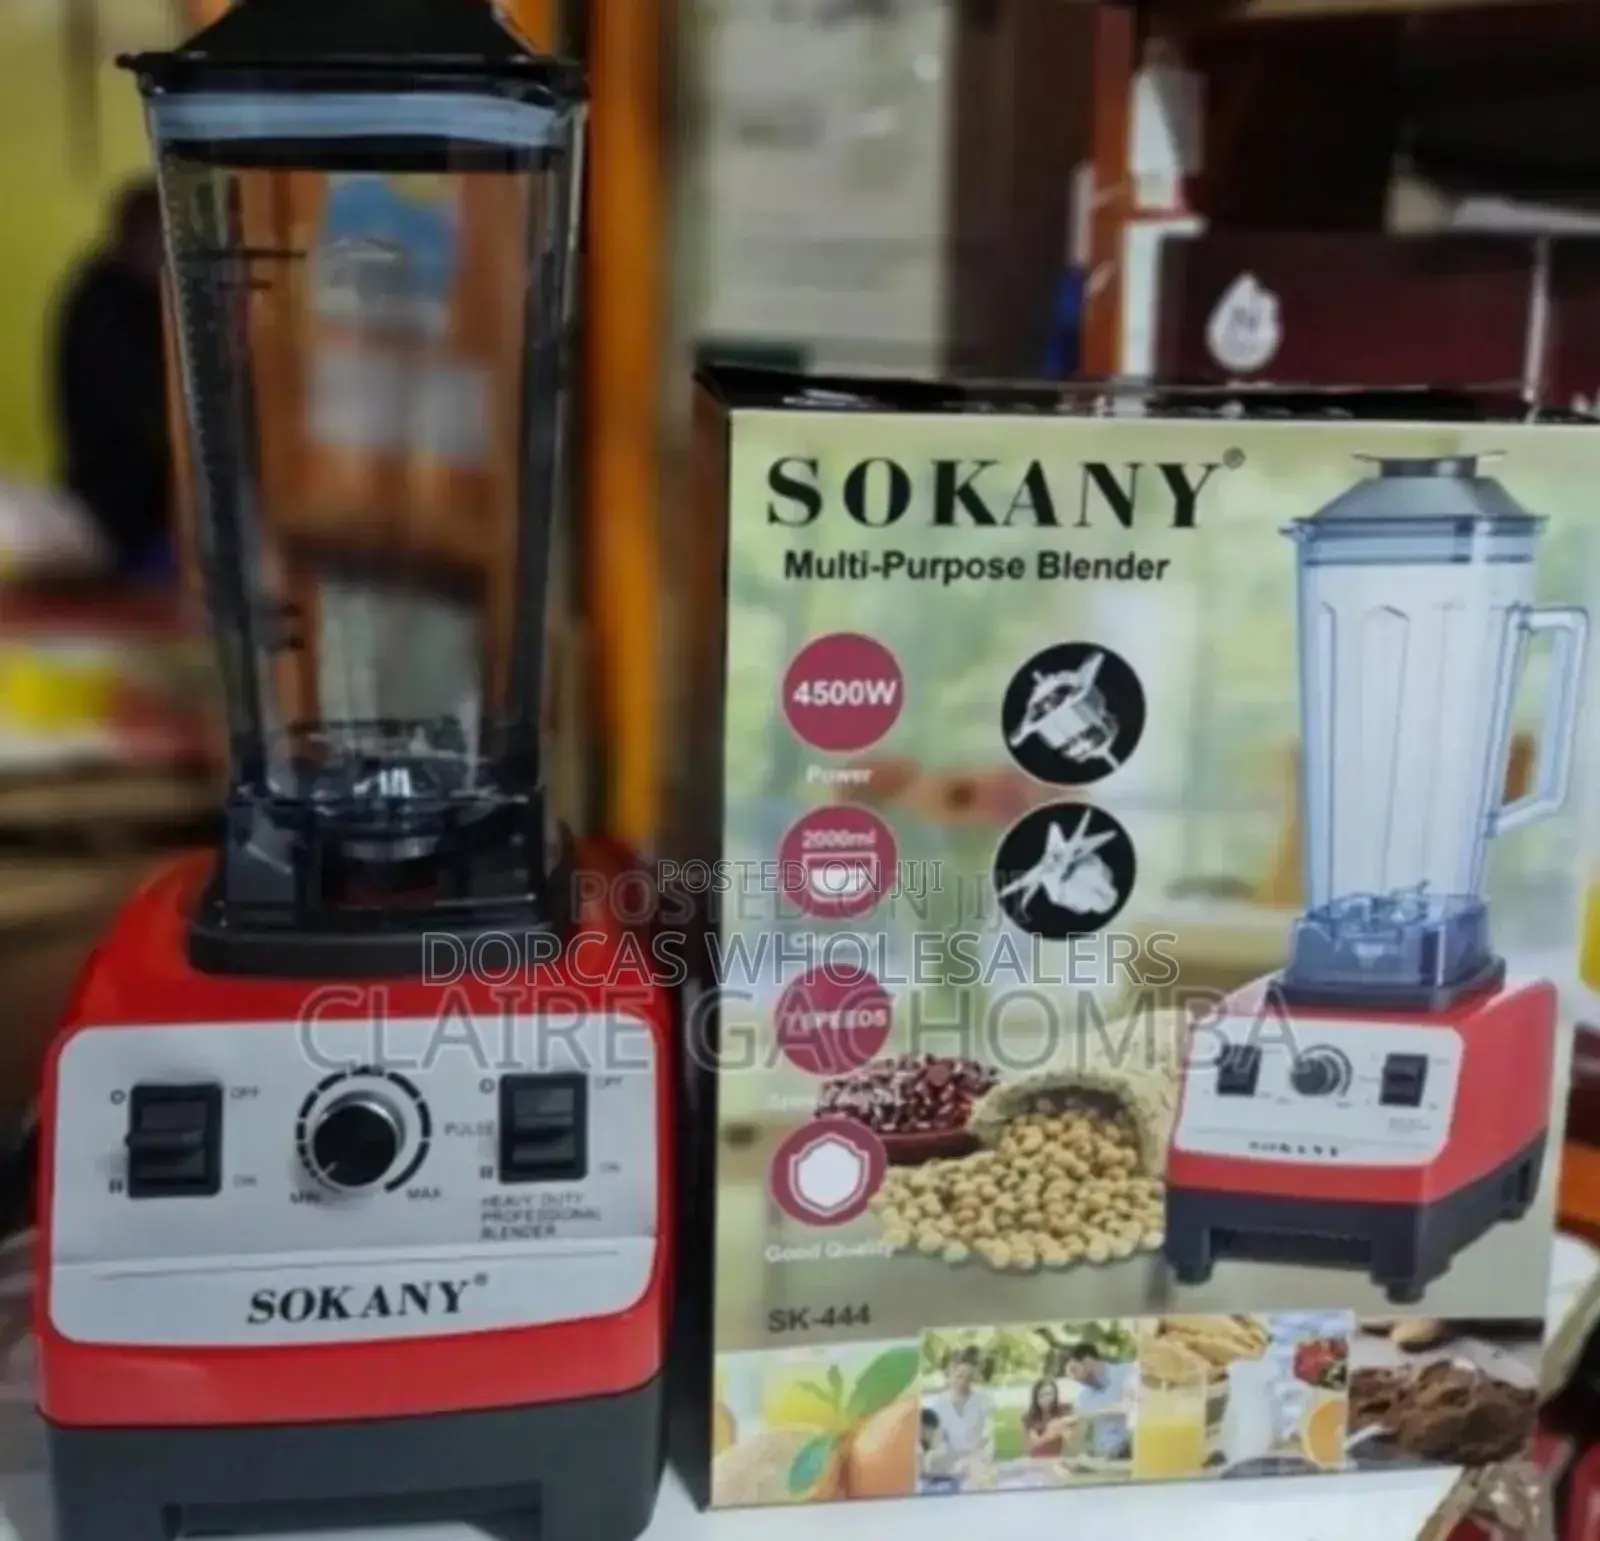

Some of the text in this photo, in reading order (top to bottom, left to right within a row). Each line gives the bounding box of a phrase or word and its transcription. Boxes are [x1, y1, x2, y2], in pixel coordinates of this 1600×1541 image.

[785, 550, 1170, 586] Multi-Purpose Blender
[793, 678, 898, 706] 4500W
[768, 1304, 871, 1333] SK-444
